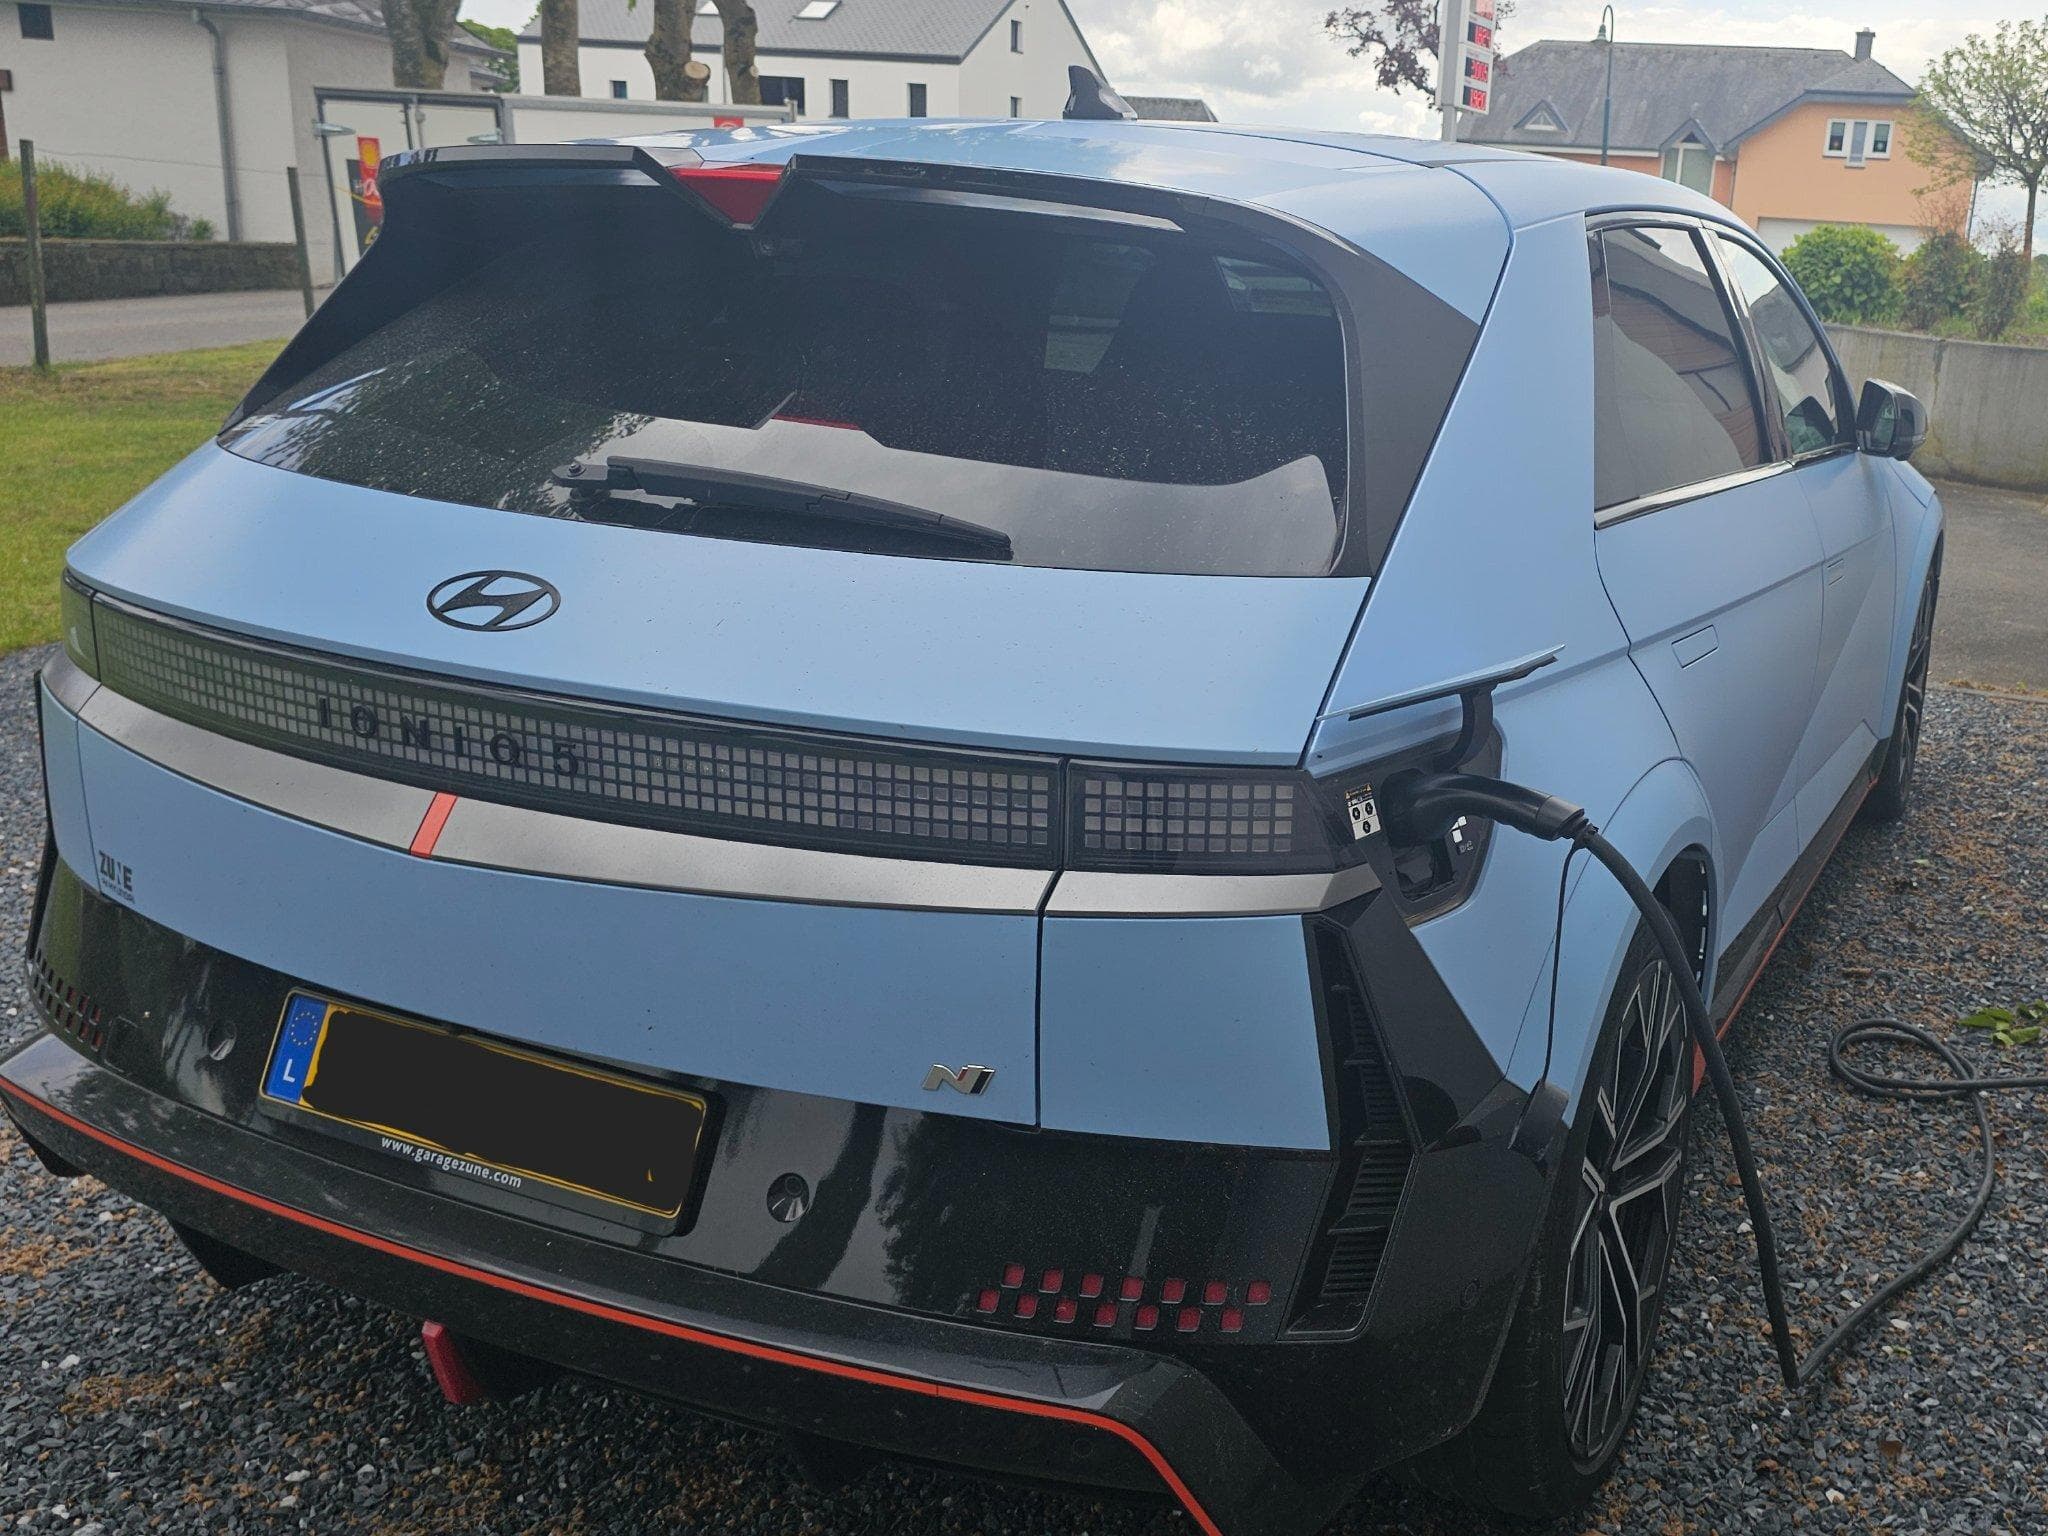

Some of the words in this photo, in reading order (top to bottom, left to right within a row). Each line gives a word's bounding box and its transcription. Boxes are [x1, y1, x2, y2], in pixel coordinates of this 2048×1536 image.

[319, 697, 522, 769] IONIQ
[553, 741, 579, 777] 5
[283, 1058, 296, 1083] L
[922, 1063, 995, 1096] N
[380, 1136, 522, 1189] www.garagezune.com
